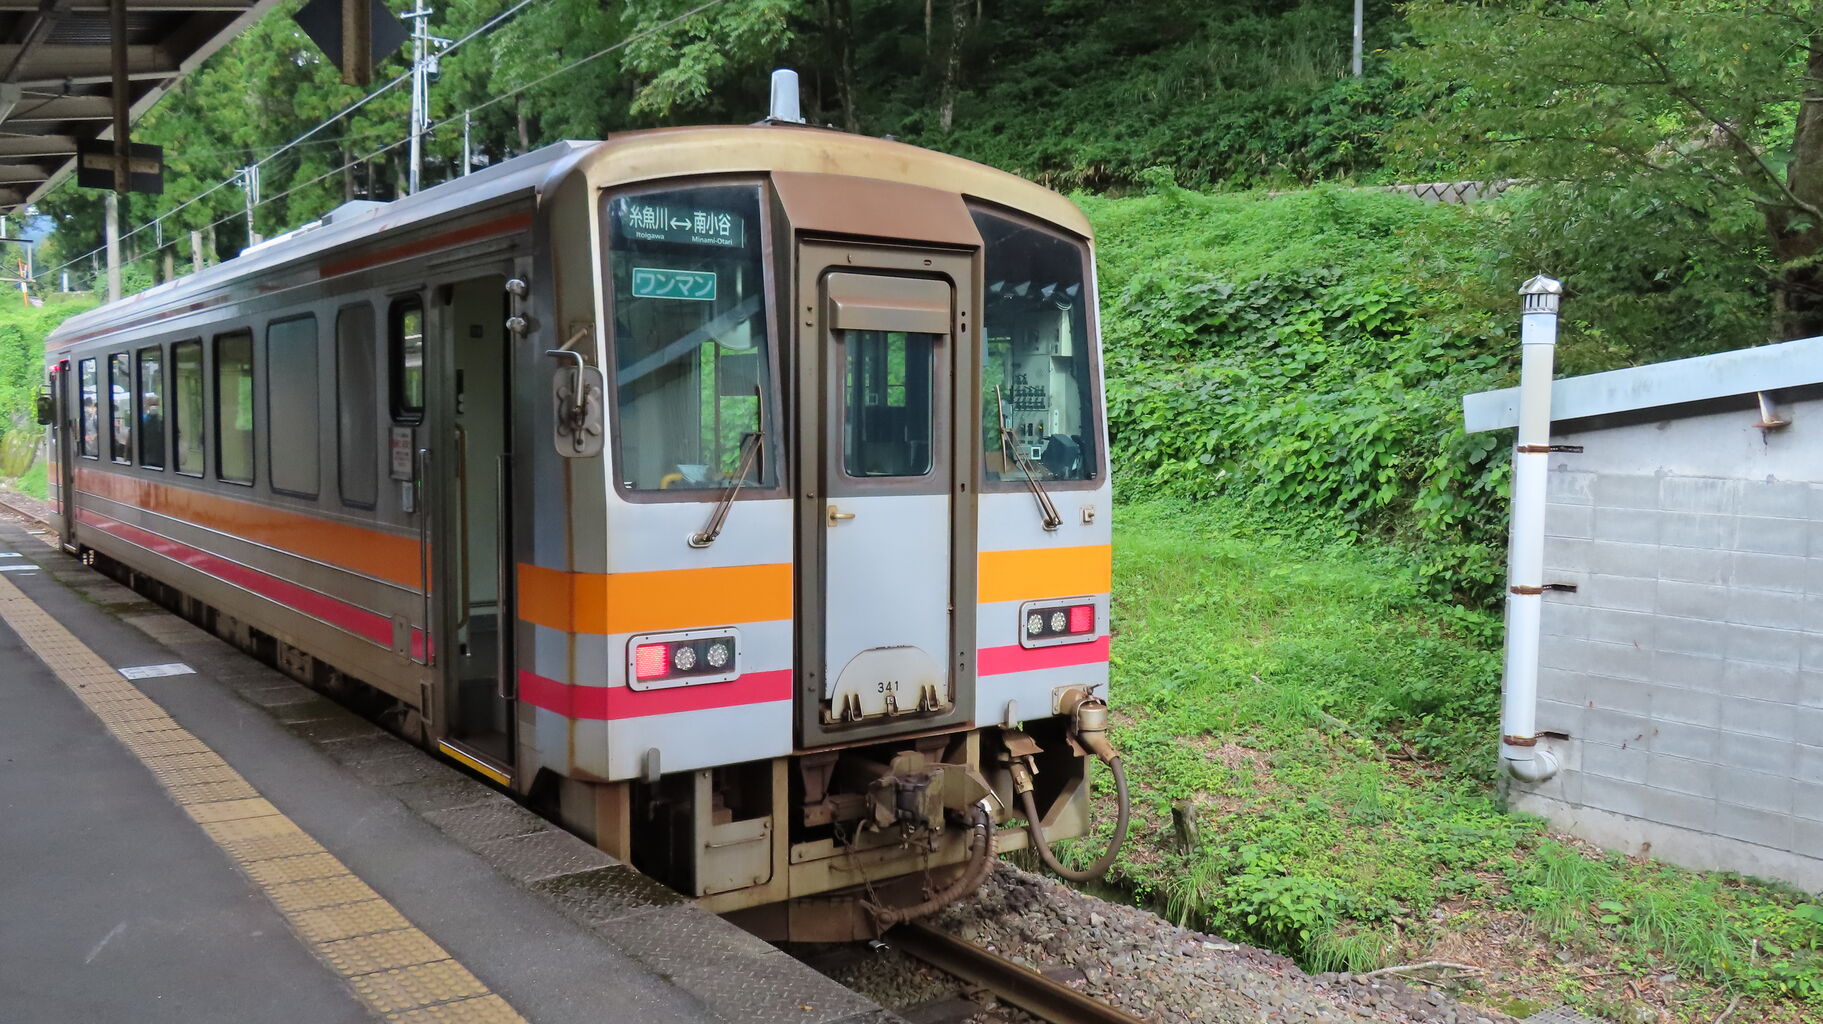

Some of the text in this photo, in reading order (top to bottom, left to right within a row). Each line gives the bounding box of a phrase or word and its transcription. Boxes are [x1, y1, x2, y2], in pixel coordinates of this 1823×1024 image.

[629, 204, 731, 236] 糸魚川 南小谷
[635, 231, 733, 246] Itoigawa Minami-Otari
[636, 272, 713, 297] ワンマン
[877, 680, 899, 694] 341
